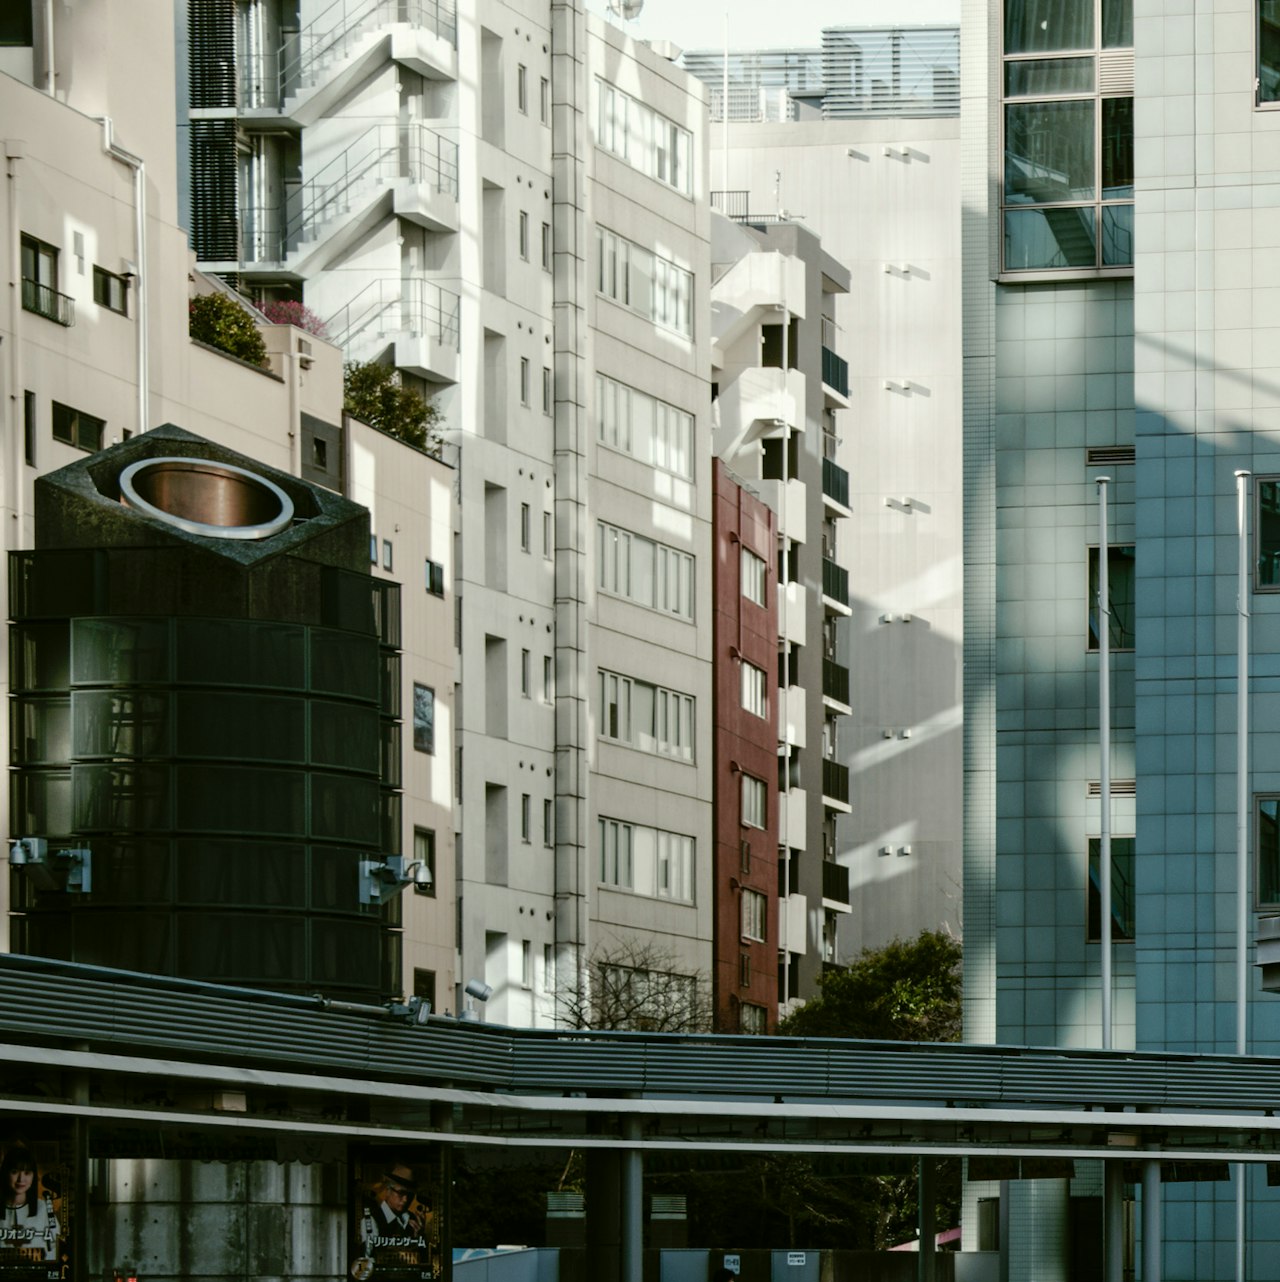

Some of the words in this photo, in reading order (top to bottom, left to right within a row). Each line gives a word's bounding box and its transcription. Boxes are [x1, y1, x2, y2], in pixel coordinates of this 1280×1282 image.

[367, 1235, 427, 1249] トリリオンゲーム
